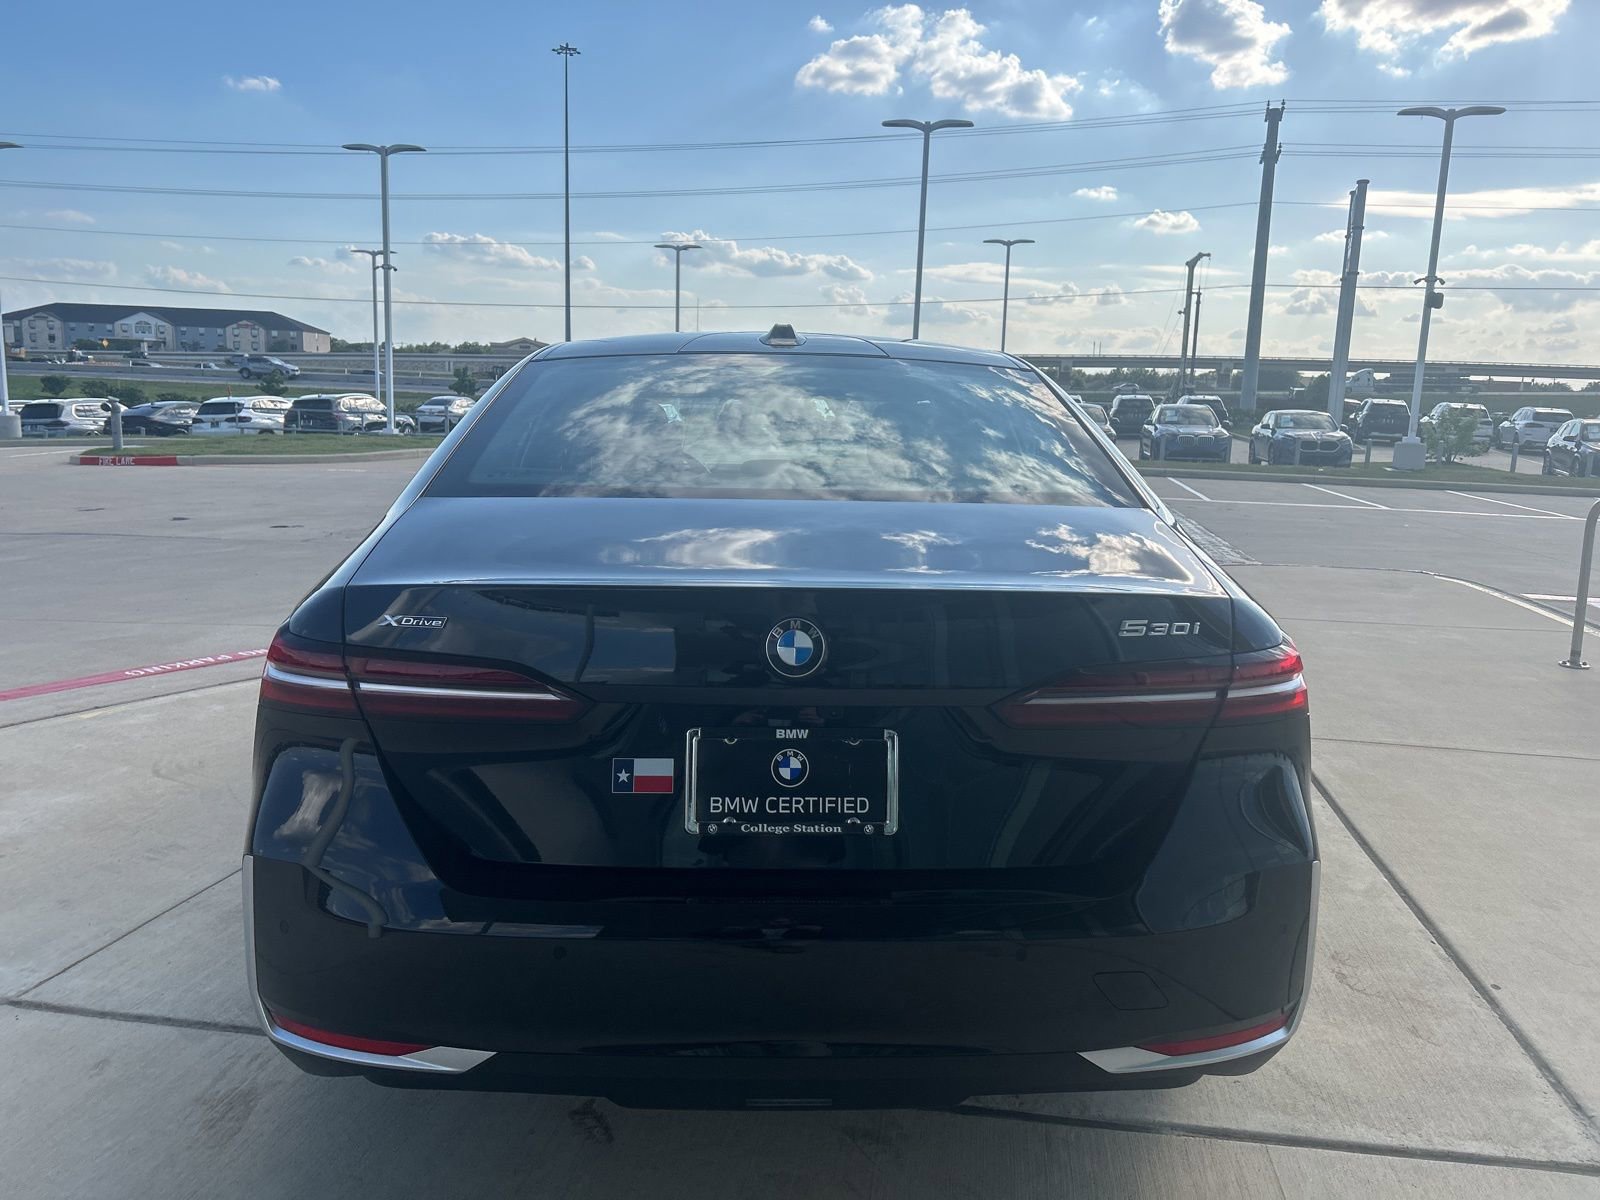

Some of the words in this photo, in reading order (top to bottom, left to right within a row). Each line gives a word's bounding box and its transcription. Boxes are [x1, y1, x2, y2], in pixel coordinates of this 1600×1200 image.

[98, 456, 114, 466] FIRE
[116, 456, 136, 466] LANE
[771, 620, 820, 639] BMW
[1118, 619, 1200, 637] 530i
[125, 654, 232, 677] PARKING
[775, 728, 809, 739] BMW
[710, 796, 759, 813] BMW
[765, 796, 870, 813] CERTIFIED
[740, 823, 790, 835] College
[792, 823, 842, 833] Station
